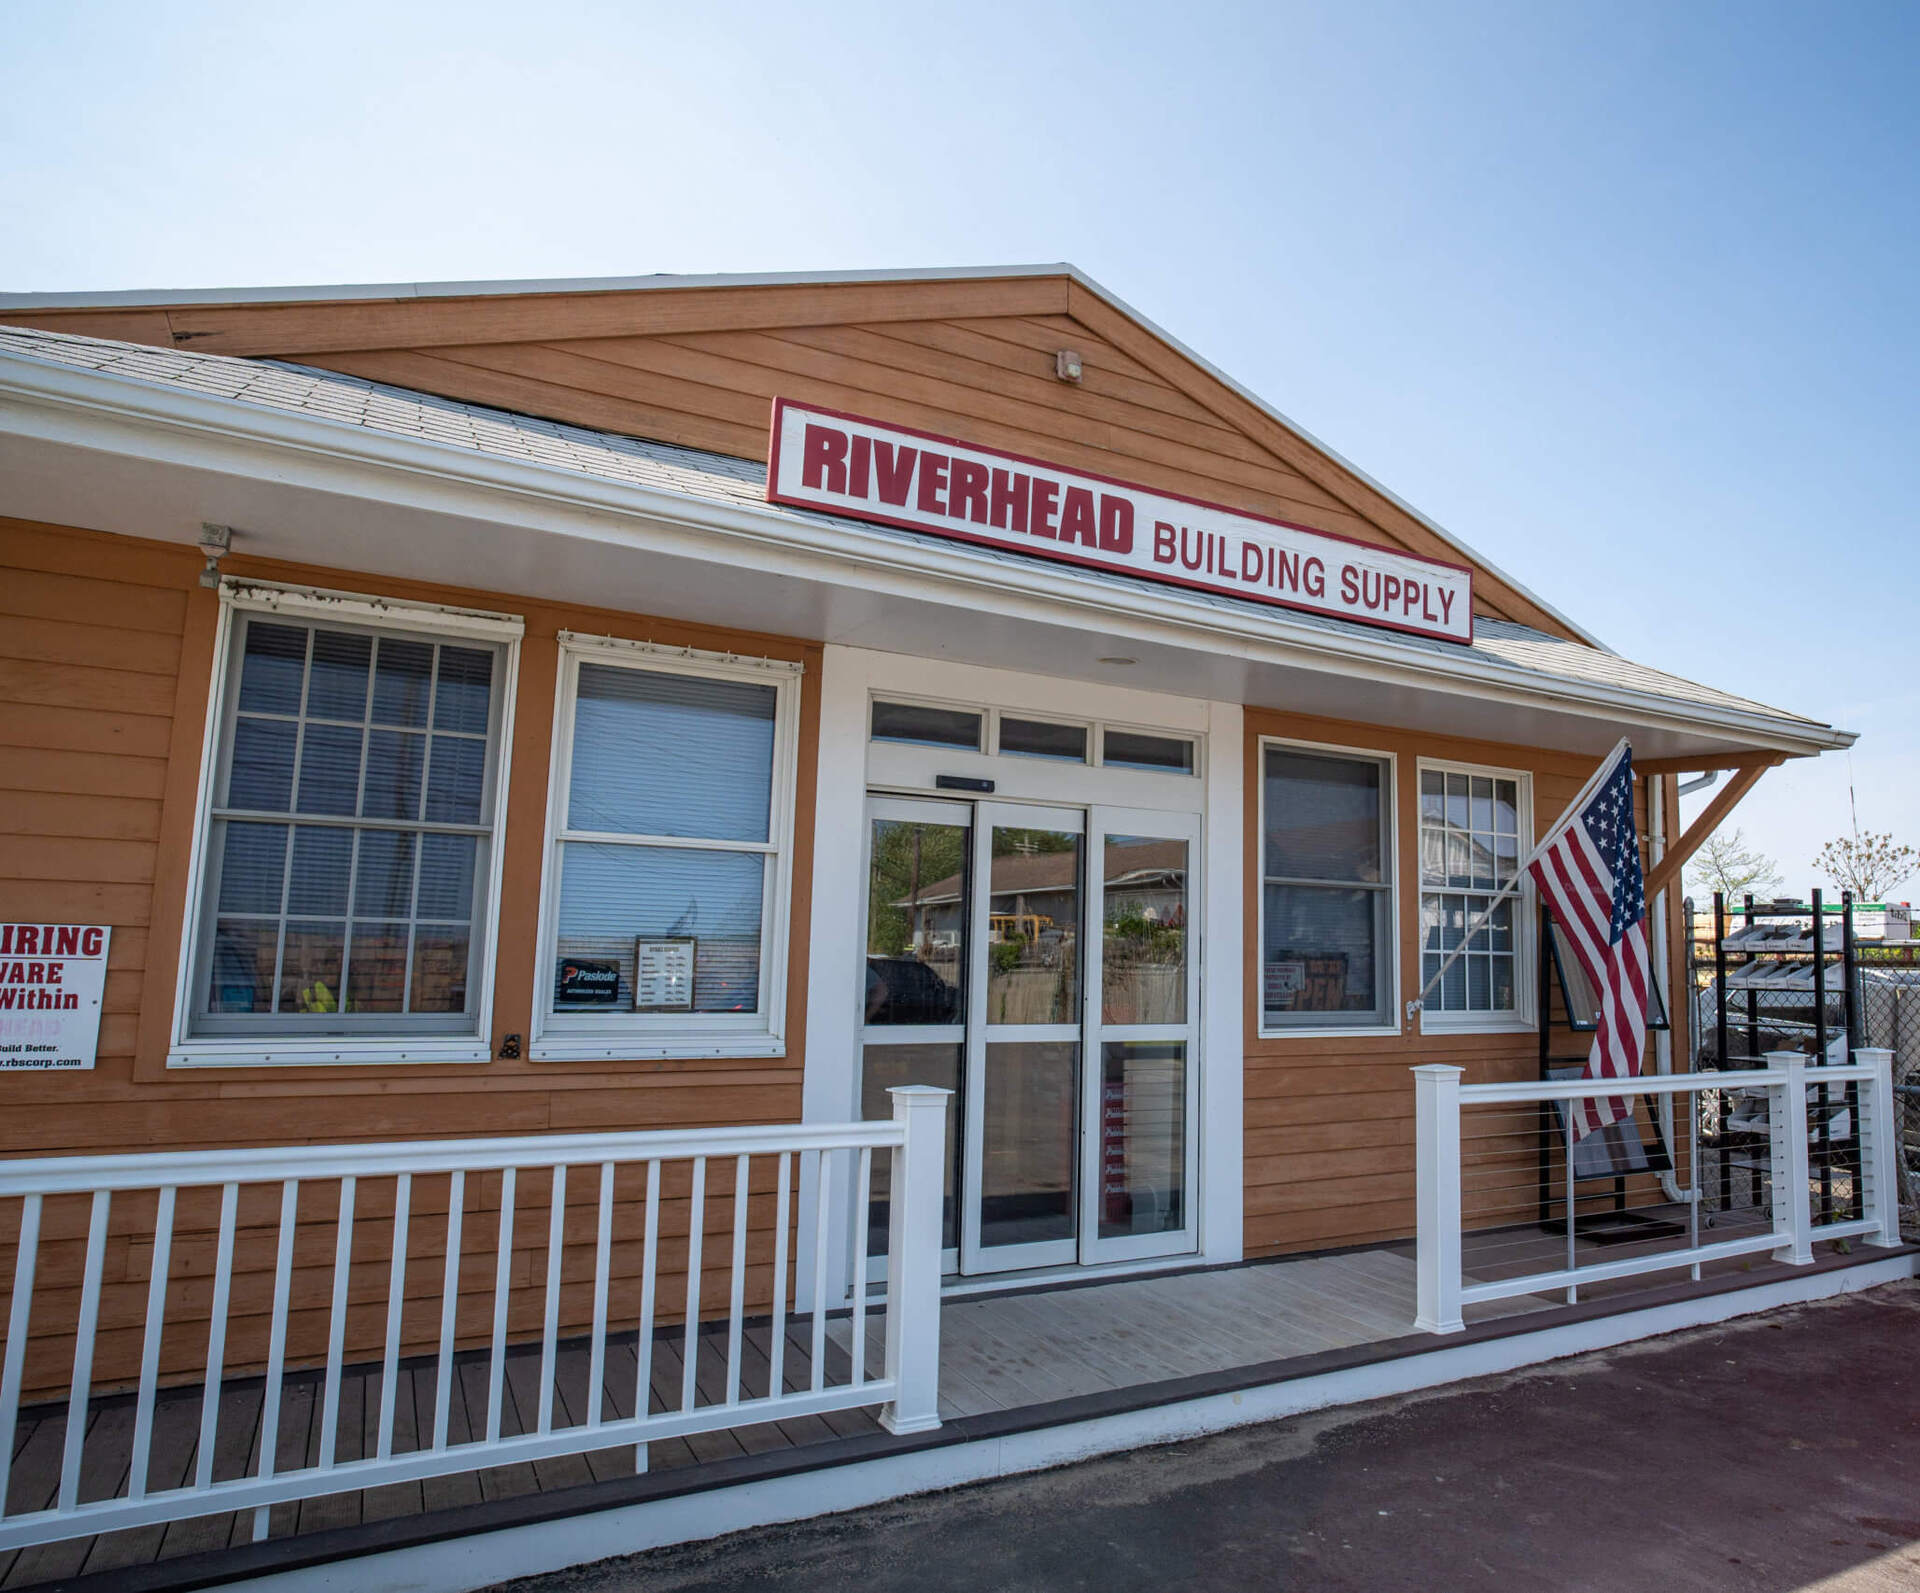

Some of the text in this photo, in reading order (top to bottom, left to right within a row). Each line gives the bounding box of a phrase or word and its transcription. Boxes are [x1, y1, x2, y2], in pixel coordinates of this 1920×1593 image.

[802, 423, 1456, 625] RIVERHEAD BUILDING SUPPLY
[577, 969, 617, 982] Paslode
[0, 987, 79, 1010] Within
[25, 1044, 59, 1053] Better.
[0, 1058, 82, 1068] .rbscorp.com
